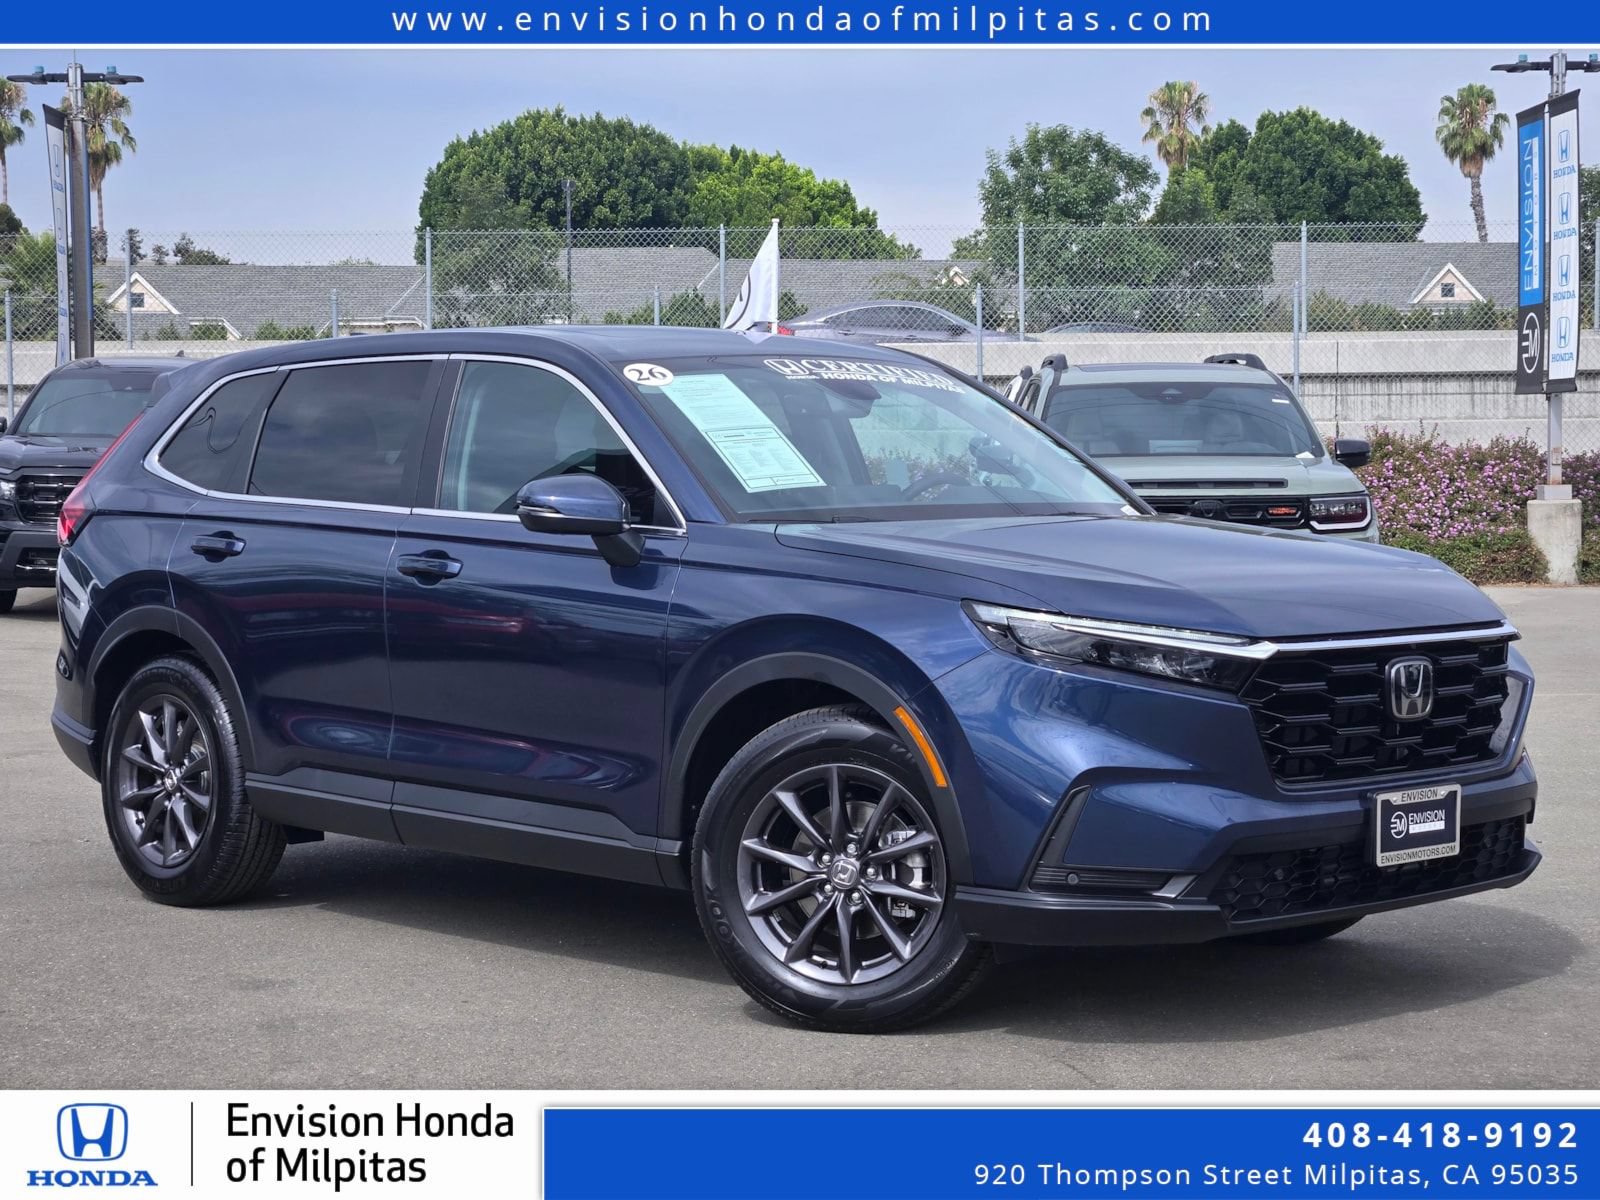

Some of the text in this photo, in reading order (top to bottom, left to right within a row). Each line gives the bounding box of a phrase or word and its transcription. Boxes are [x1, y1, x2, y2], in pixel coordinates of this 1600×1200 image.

[1553, 164, 1576, 179] HONDA
[1523, 138, 1534, 291] ENVISION
[1553, 227, 1577, 241] HONDA
[1552, 290, 1576, 302] HONDA
[1551, 352, 1575, 363] HONDA
[627, 366, 668, 381] 26
[821, 372, 879, 382] HONDA
[878, 375, 898, 383] OF
[1400, 789, 1438, 802] ENVISION
[1408, 810, 1446, 825] ENVISION
[1380, 844, 1456, 865] ENVISIONMOTORS.COM
